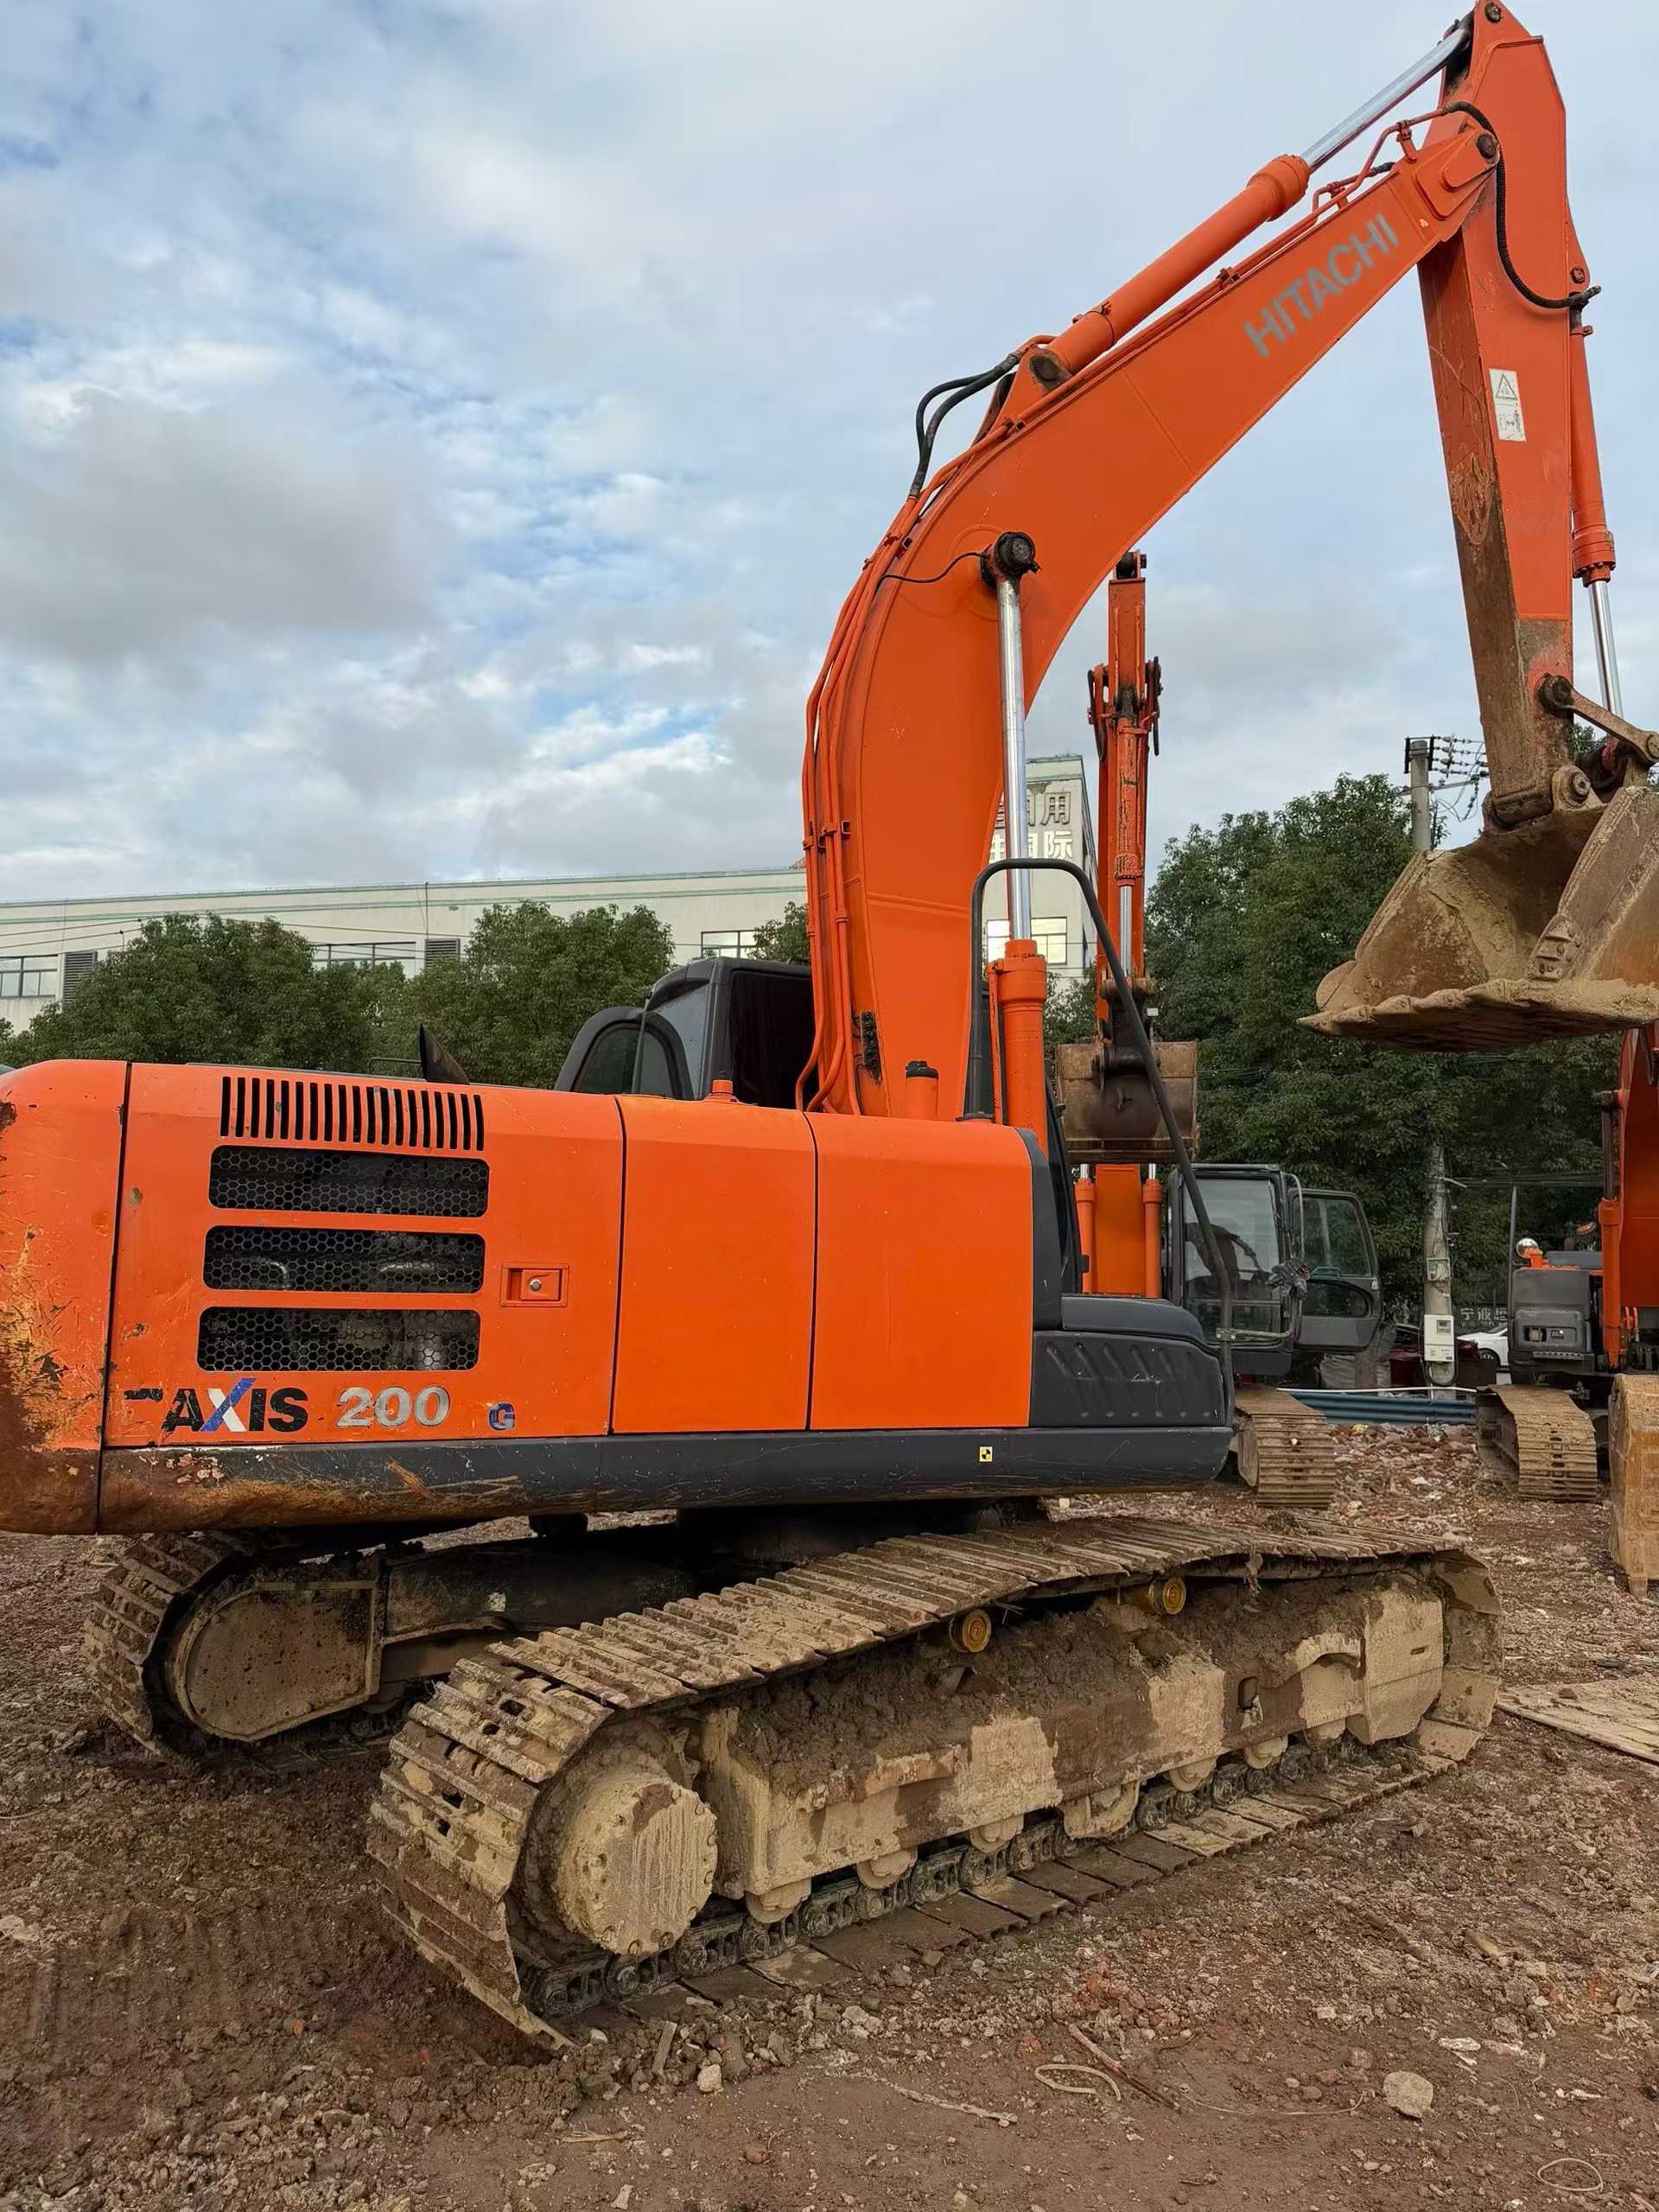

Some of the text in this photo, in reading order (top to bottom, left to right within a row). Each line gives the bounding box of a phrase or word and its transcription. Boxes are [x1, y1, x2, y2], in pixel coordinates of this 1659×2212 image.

[1243, 213, 1398, 359] HITACHI
[124, 1377, 309, 1433] AXIS
[336, 1385, 451, 1427] 200
